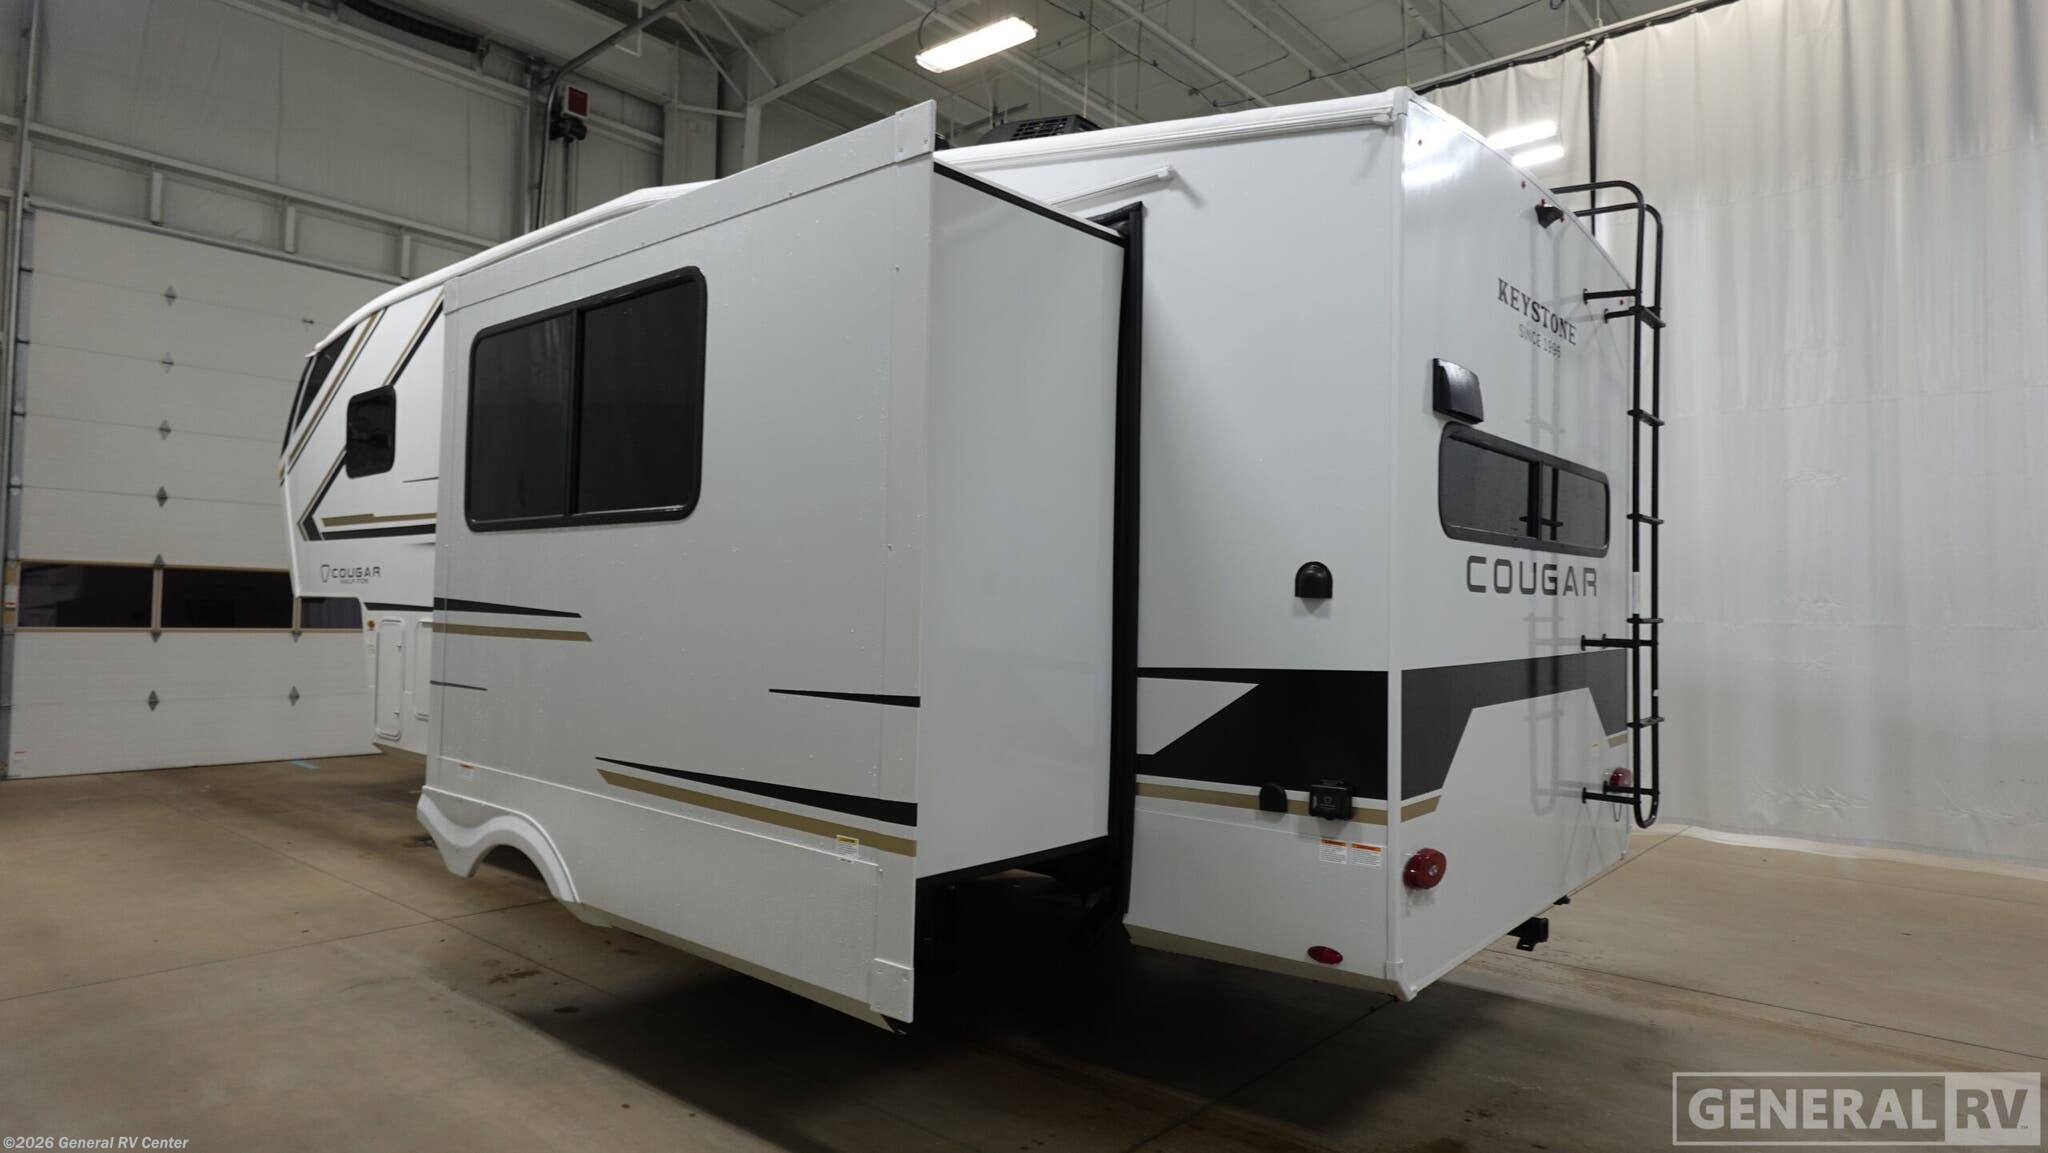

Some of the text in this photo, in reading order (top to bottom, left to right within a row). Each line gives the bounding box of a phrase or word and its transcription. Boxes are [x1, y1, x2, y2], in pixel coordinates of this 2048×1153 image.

[1498, 277, 1576, 345] KEYSTONE
[1519, 323, 1541, 348] SINCE
[331, 566, 381, 579] COUGAR
[1466, 555, 1597, 596] COUGAR
